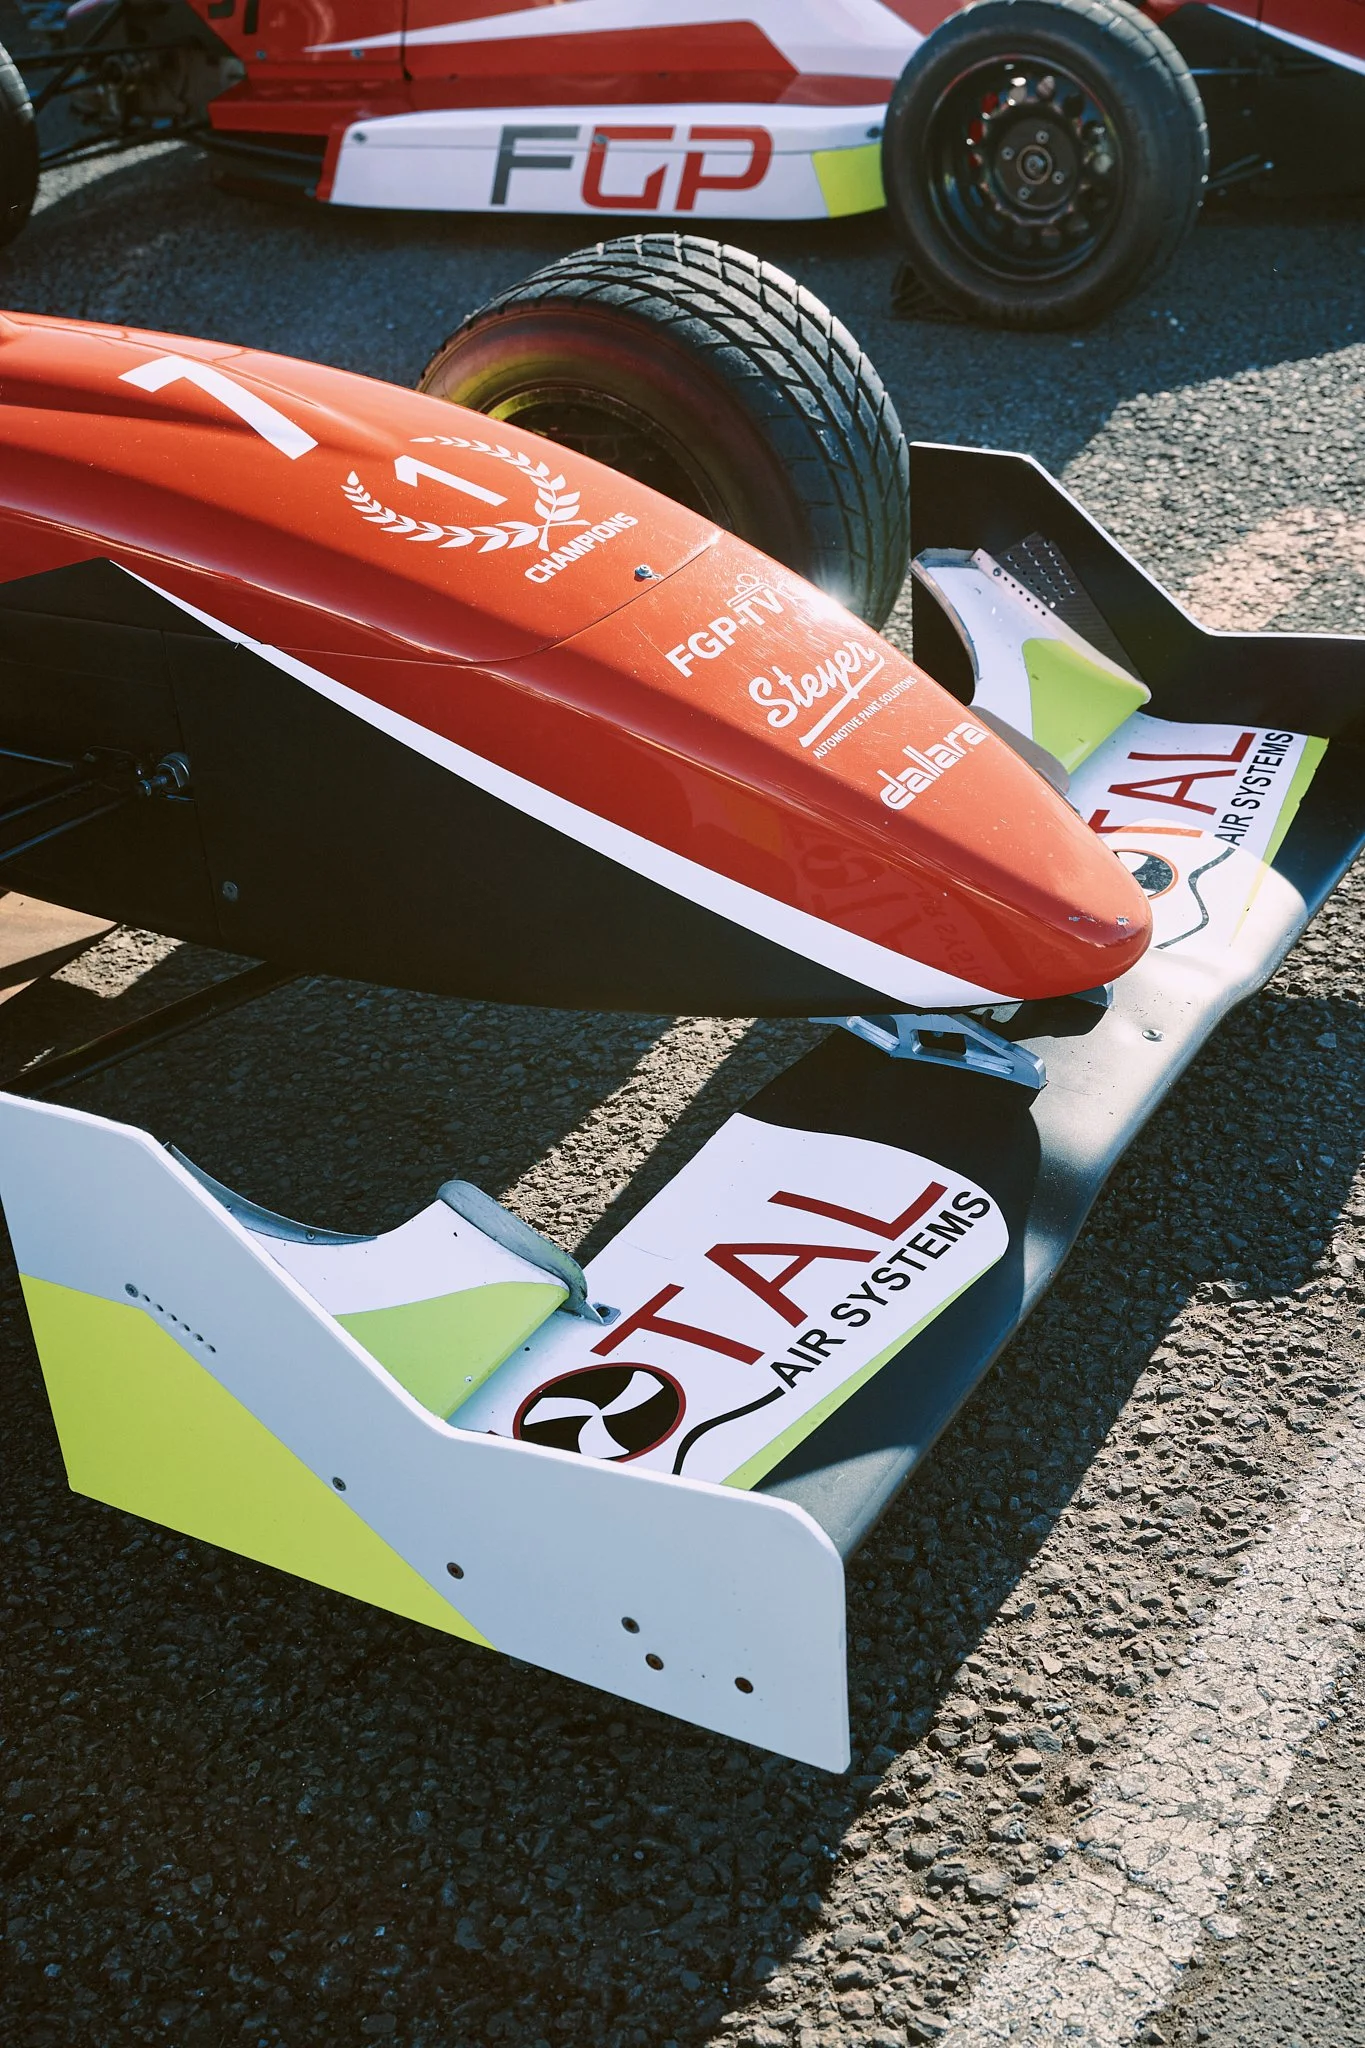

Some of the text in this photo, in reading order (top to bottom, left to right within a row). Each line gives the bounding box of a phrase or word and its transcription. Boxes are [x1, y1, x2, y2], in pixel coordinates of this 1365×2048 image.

[490, 125, 772, 211] FGP
[117, 355, 319, 460] 7
[394, 454, 508, 507] 1
[524, 511, 638, 584] CHAMPIONS
[665, 587, 785, 677] FGP-TV
[748, 640, 885, 748] Steyer
[812, 675, 918, 760] AUTOMOTIVE PAINT SOLUTIONS
[876, 721, 990, 810] dallara
[1214, 732, 1294, 846] AIR SYSTEMS
[769, 1191, 991, 1390] AIR SYSTEMS
